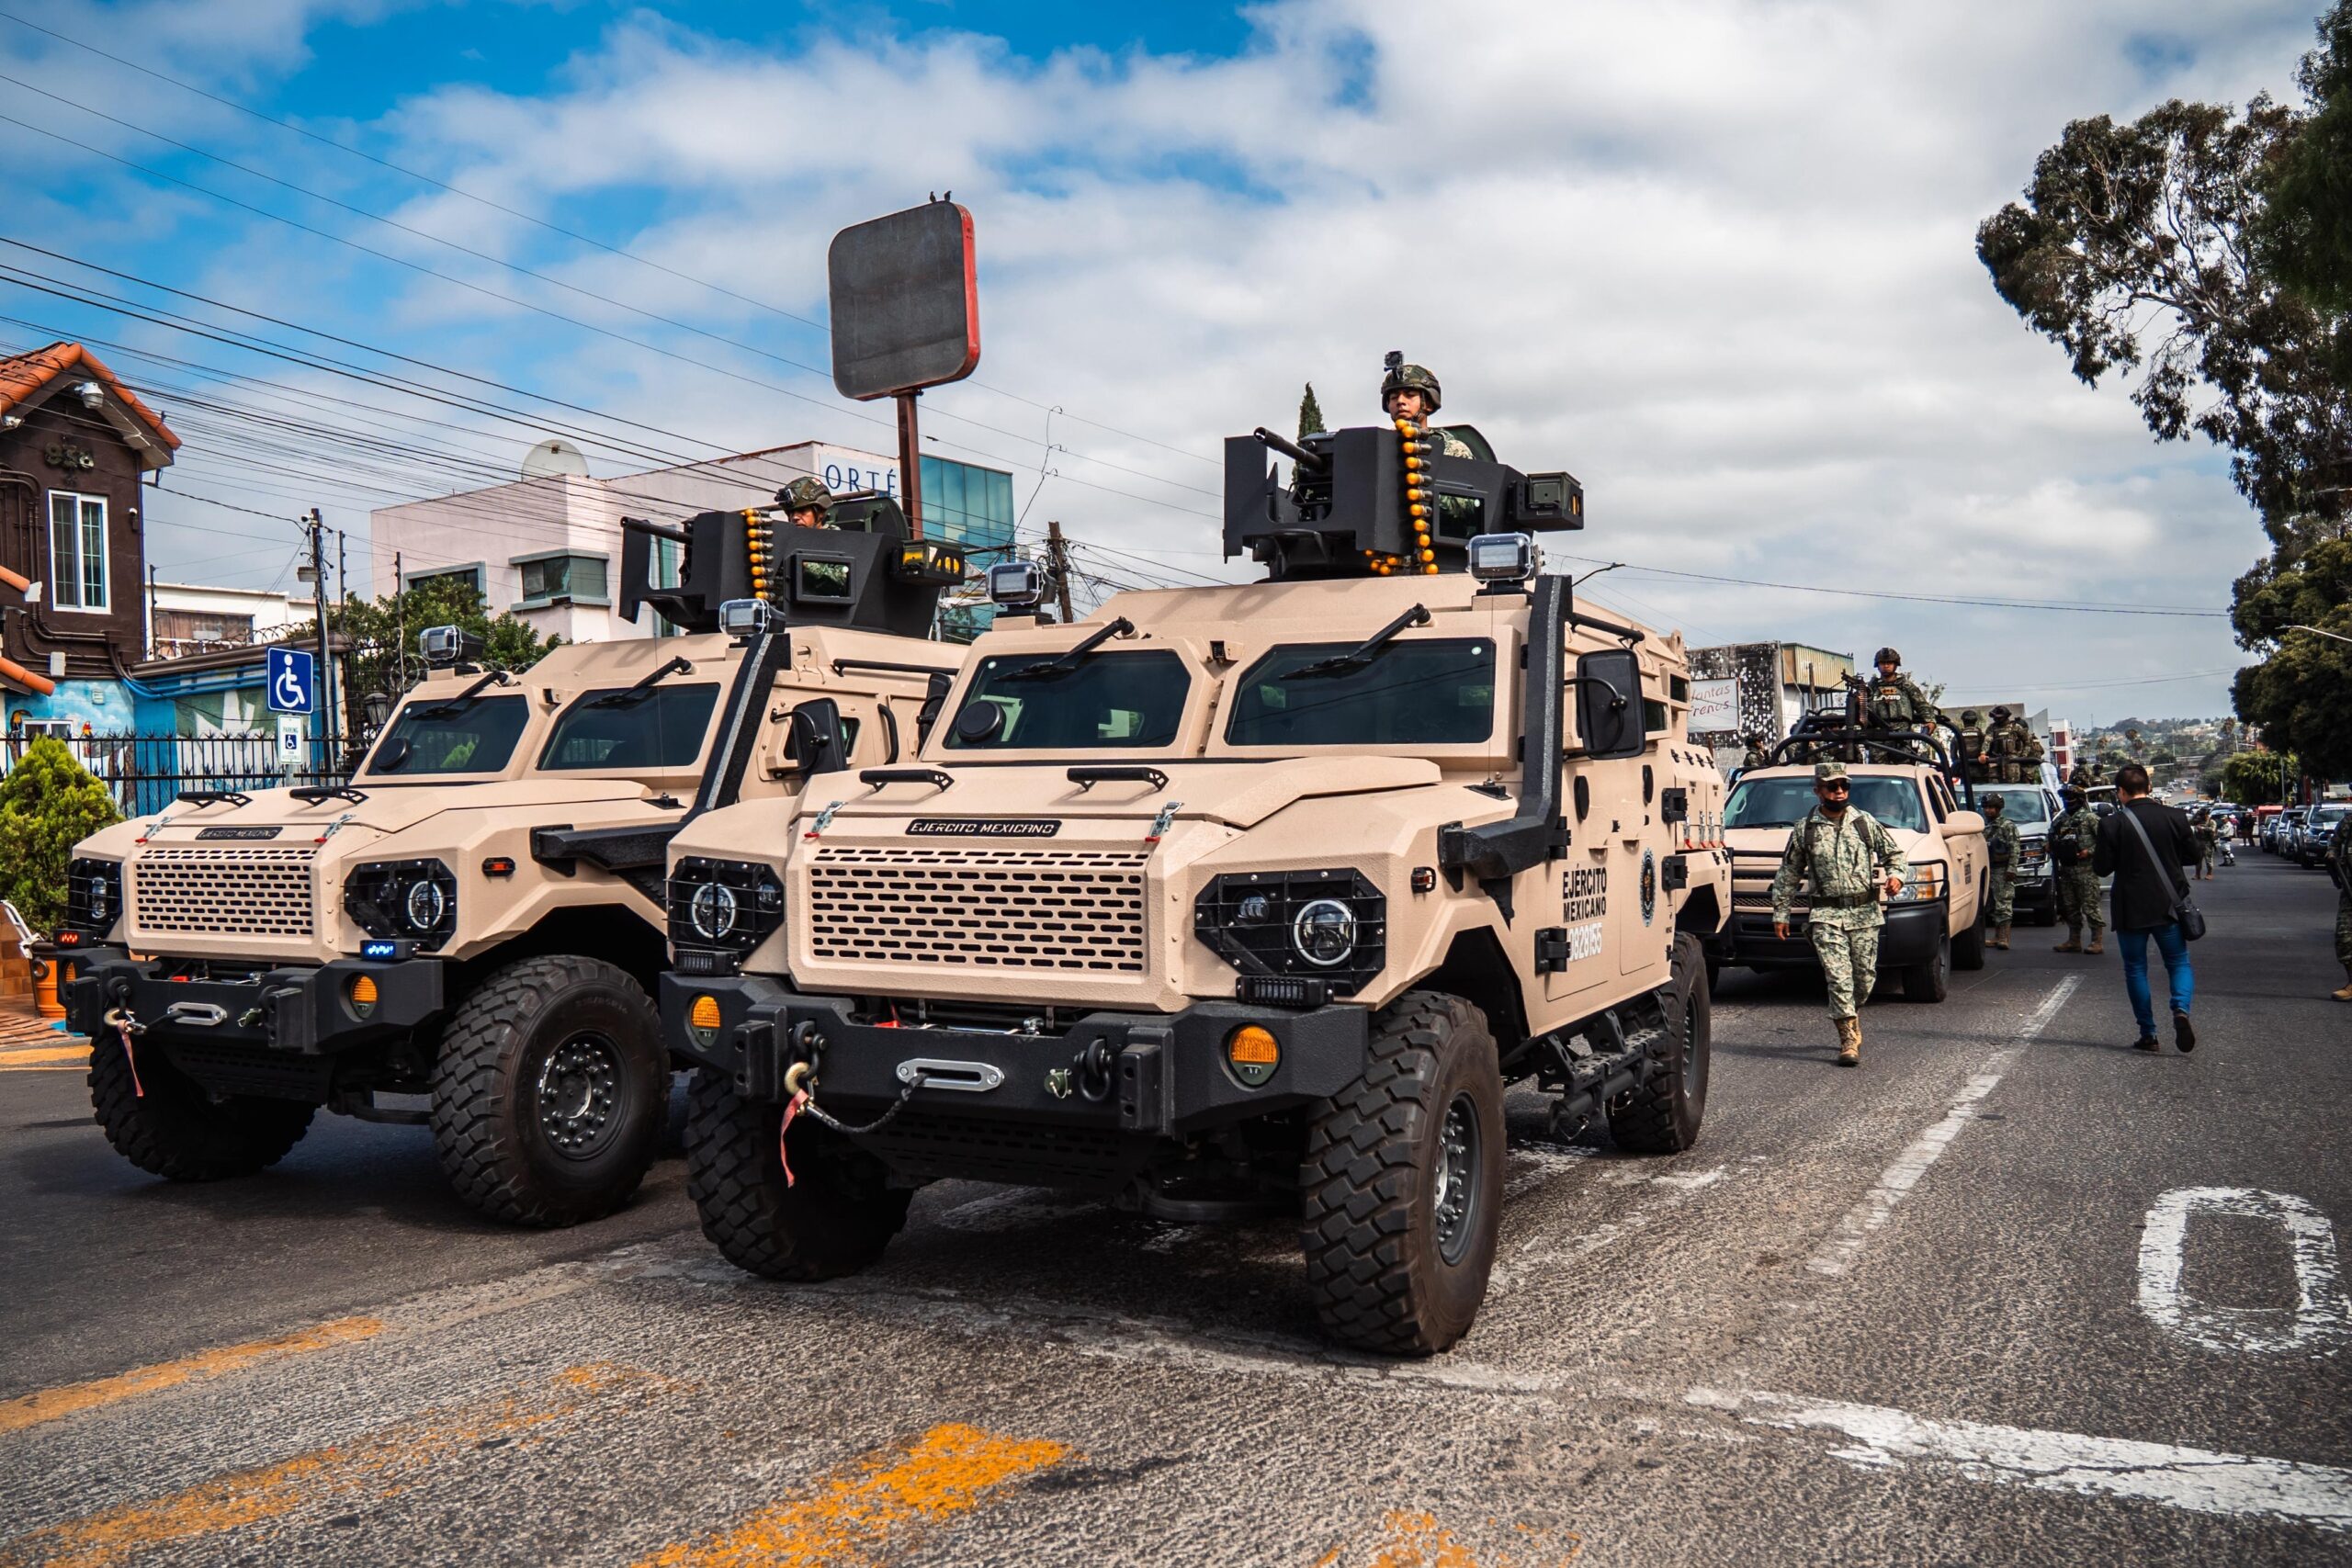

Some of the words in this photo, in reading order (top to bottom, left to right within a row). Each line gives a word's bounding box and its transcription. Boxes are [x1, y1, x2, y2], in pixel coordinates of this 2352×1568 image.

[1690, 684, 1730, 701] lantas
[1690, 700, 1729, 717] renos
[910, 822, 977, 833] EJERCITO
[979, 823, 1055, 834] MEXICANO
[1563, 863, 1607, 899] EJÉRCITO
[1563, 896, 1607, 923] MEXICANO
